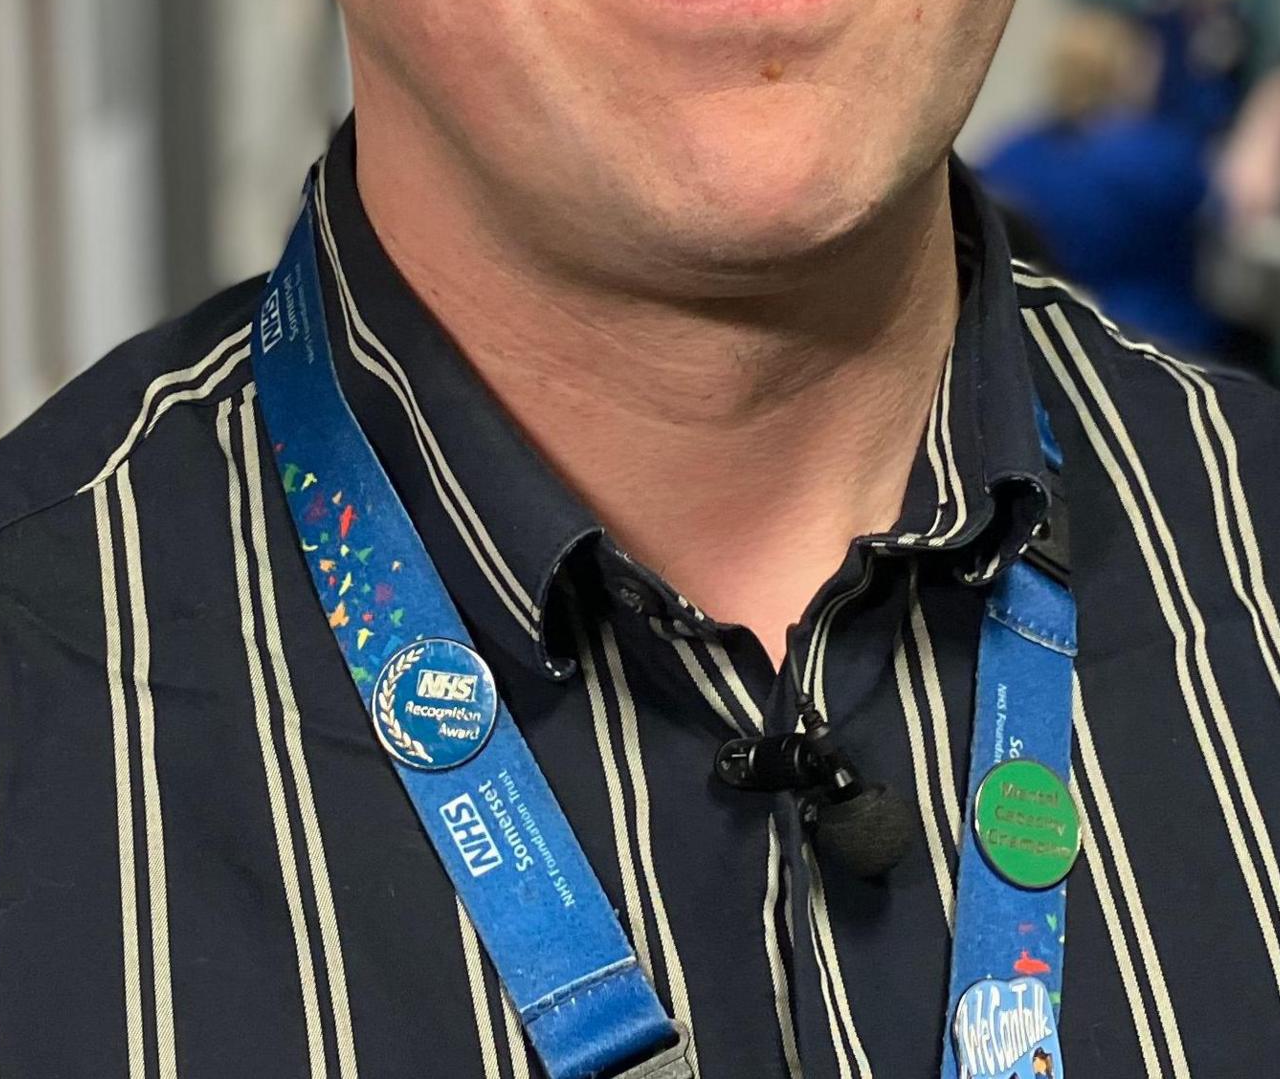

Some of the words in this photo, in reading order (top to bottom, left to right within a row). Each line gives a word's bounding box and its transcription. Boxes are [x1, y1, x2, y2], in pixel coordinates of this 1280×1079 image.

[262, 290, 282, 350] NHS
[418, 671, 476, 700] NHS
[405, 701, 481, 722] Recognition
[438, 722, 480, 740] Award
[1009, 736, 1024, 759] So
[498, 768, 520, 804] Trust
[442, 801, 500, 870] NHS
[478, 779, 534, 872] Somerset
[517, 803, 560, 877] Foundation
[553, 876, 576, 907] NHS
